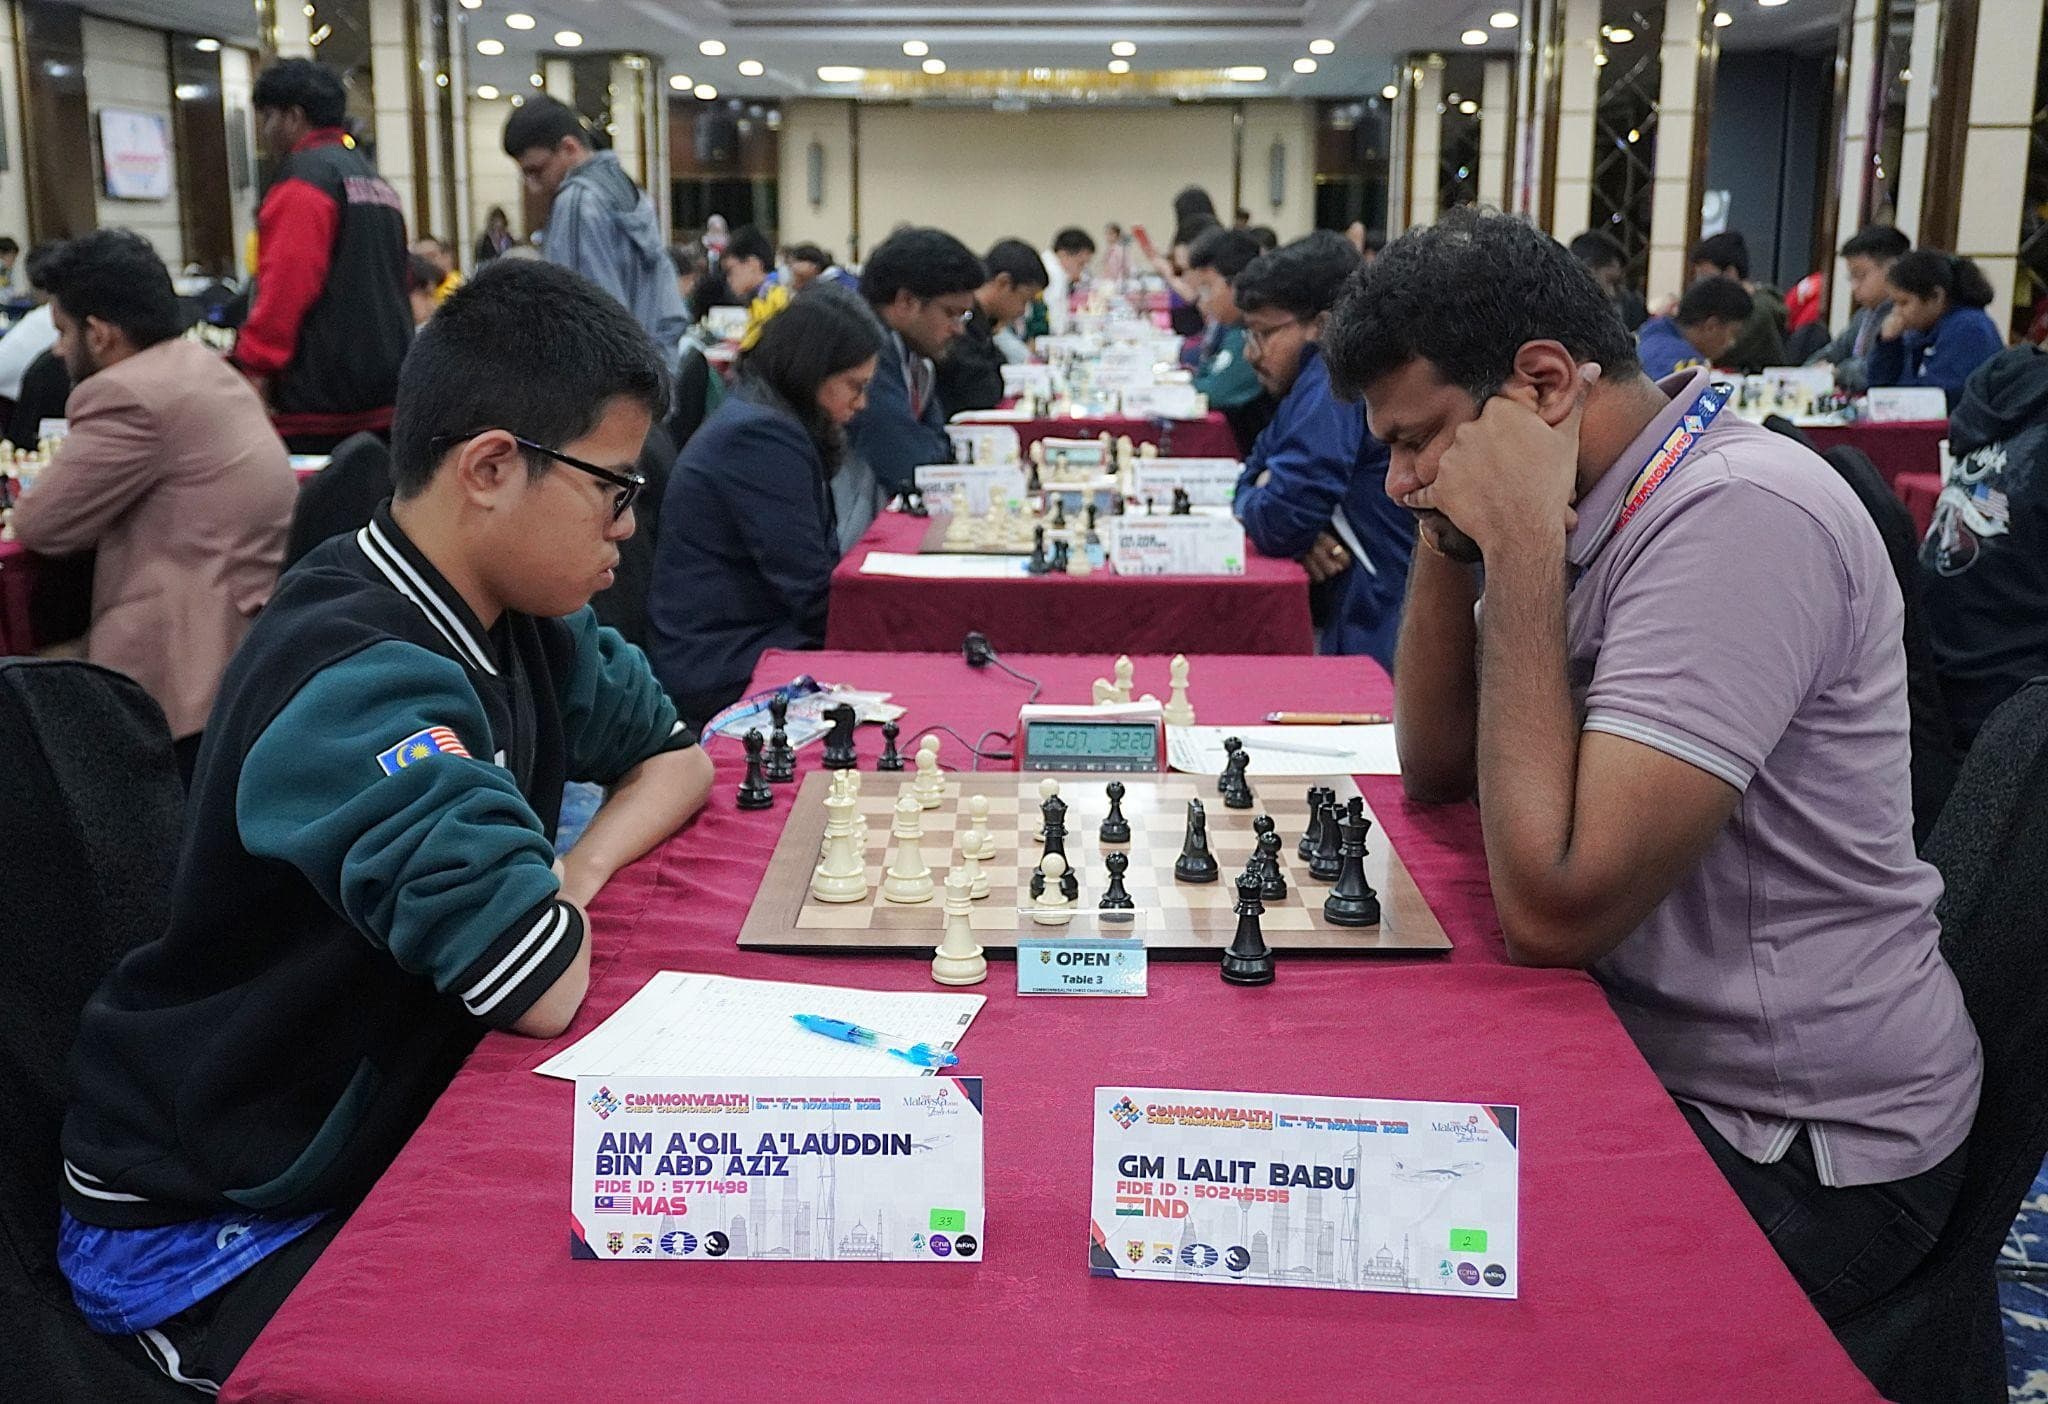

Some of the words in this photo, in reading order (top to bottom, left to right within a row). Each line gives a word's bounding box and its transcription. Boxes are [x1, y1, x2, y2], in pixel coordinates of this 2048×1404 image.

[1056, 951, 1110, 967] OPEN
[1062, 975, 1093, 985] Table
[1096, 975, 1104, 985] 3
[625, 1094, 749, 1107] COMMONWEALTH
[1146, 1104, 1273, 1123] COMMONWEALTH
[597, 1132, 652, 1155] AIM
[666, 1132, 743, 1155] A'QIL
[756, 1133, 912, 1156] A'LAUDDIN
[596, 1155, 643, 1176] BIN
[655, 1155, 713, 1176] ABD
[726, 1155, 789, 1177] AZIZ
[1118, 1155, 1164, 1179] GM
[1177, 1157, 1256, 1184] LALIT
[1269, 1163, 1355, 1191] BABU
[594, 1180, 632, 1193] FIDE
[638, 1180, 655, 1193] ID
[672, 1180, 748, 1194] 5771498
[1116, 1180, 1153, 1195] FIDE
[1159, 1182, 1177, 1196] ID
[1194, 1184, 1290, 1204] 50245595
[632, 1196, 688, 1216] MAS
[1145, 1197, 1189, 1219] IND
[937, 1216, 953, 1226] 33
[1463, 1236, 1471, 1246] 2
